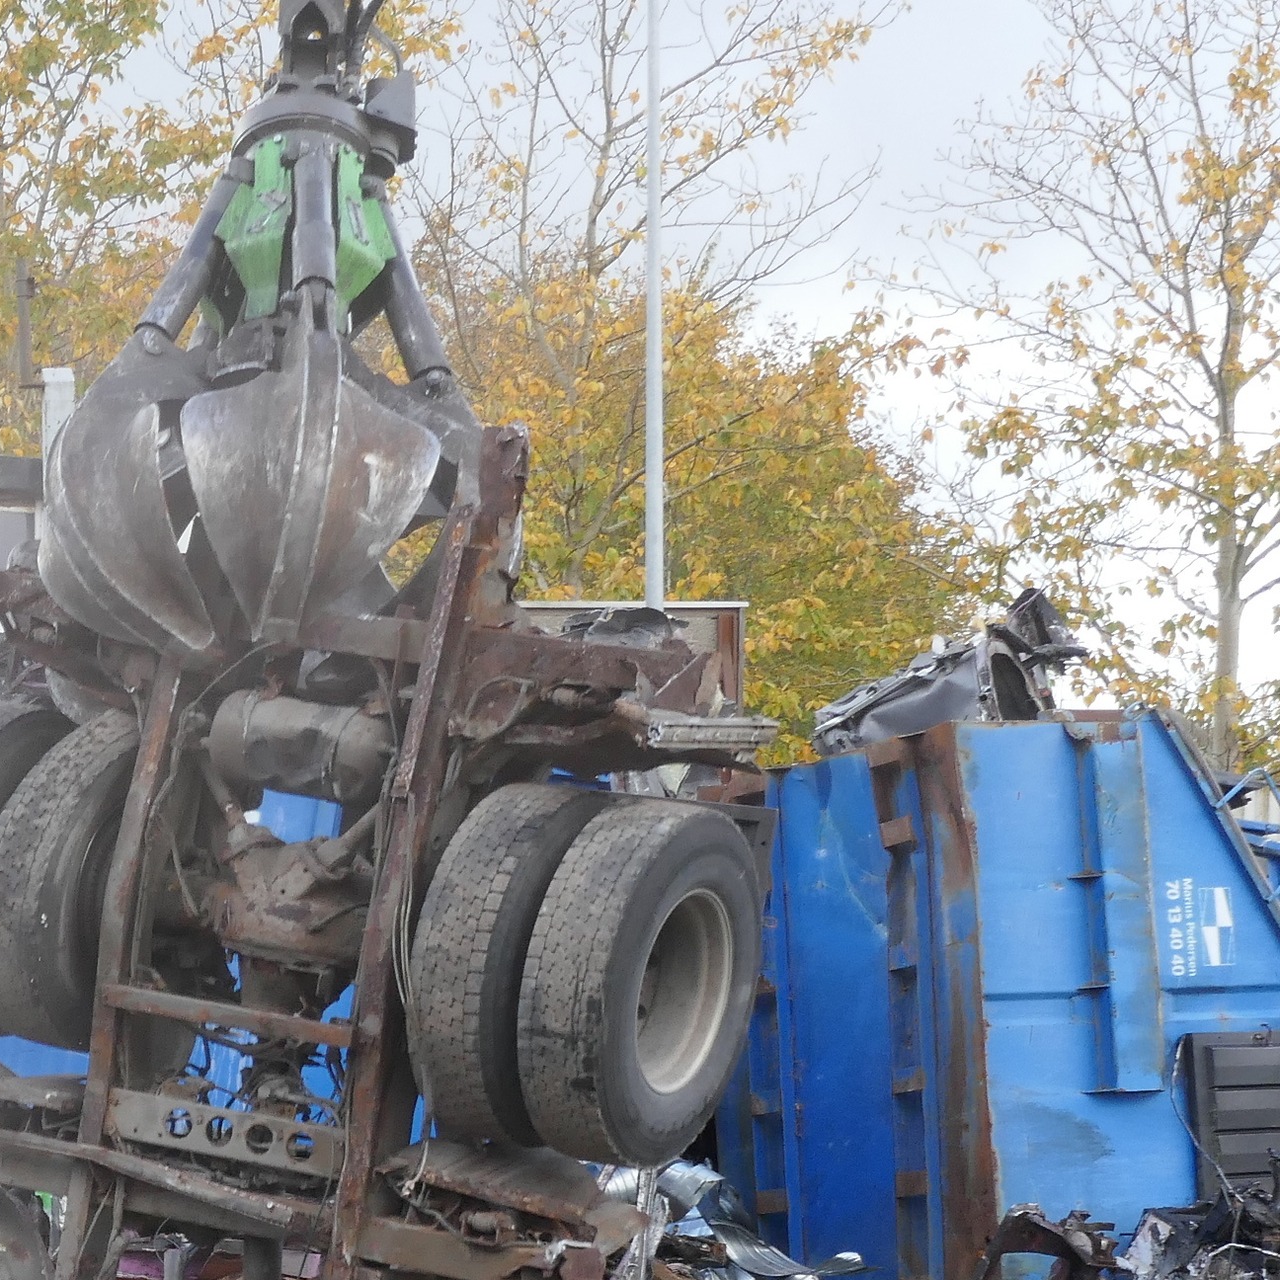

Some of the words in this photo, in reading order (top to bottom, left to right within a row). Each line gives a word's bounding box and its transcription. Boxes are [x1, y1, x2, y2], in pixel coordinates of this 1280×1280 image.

[1165, 880, 1180, 900] 70
[1182, 878, 1194, 919] Marius
[1167, 906, 1182, 923] 13
[1169, 928, 1183, 950] 40
[1186, 921, 1197, 977] Pedersen
[1171, 954, 1185, 977] 40
